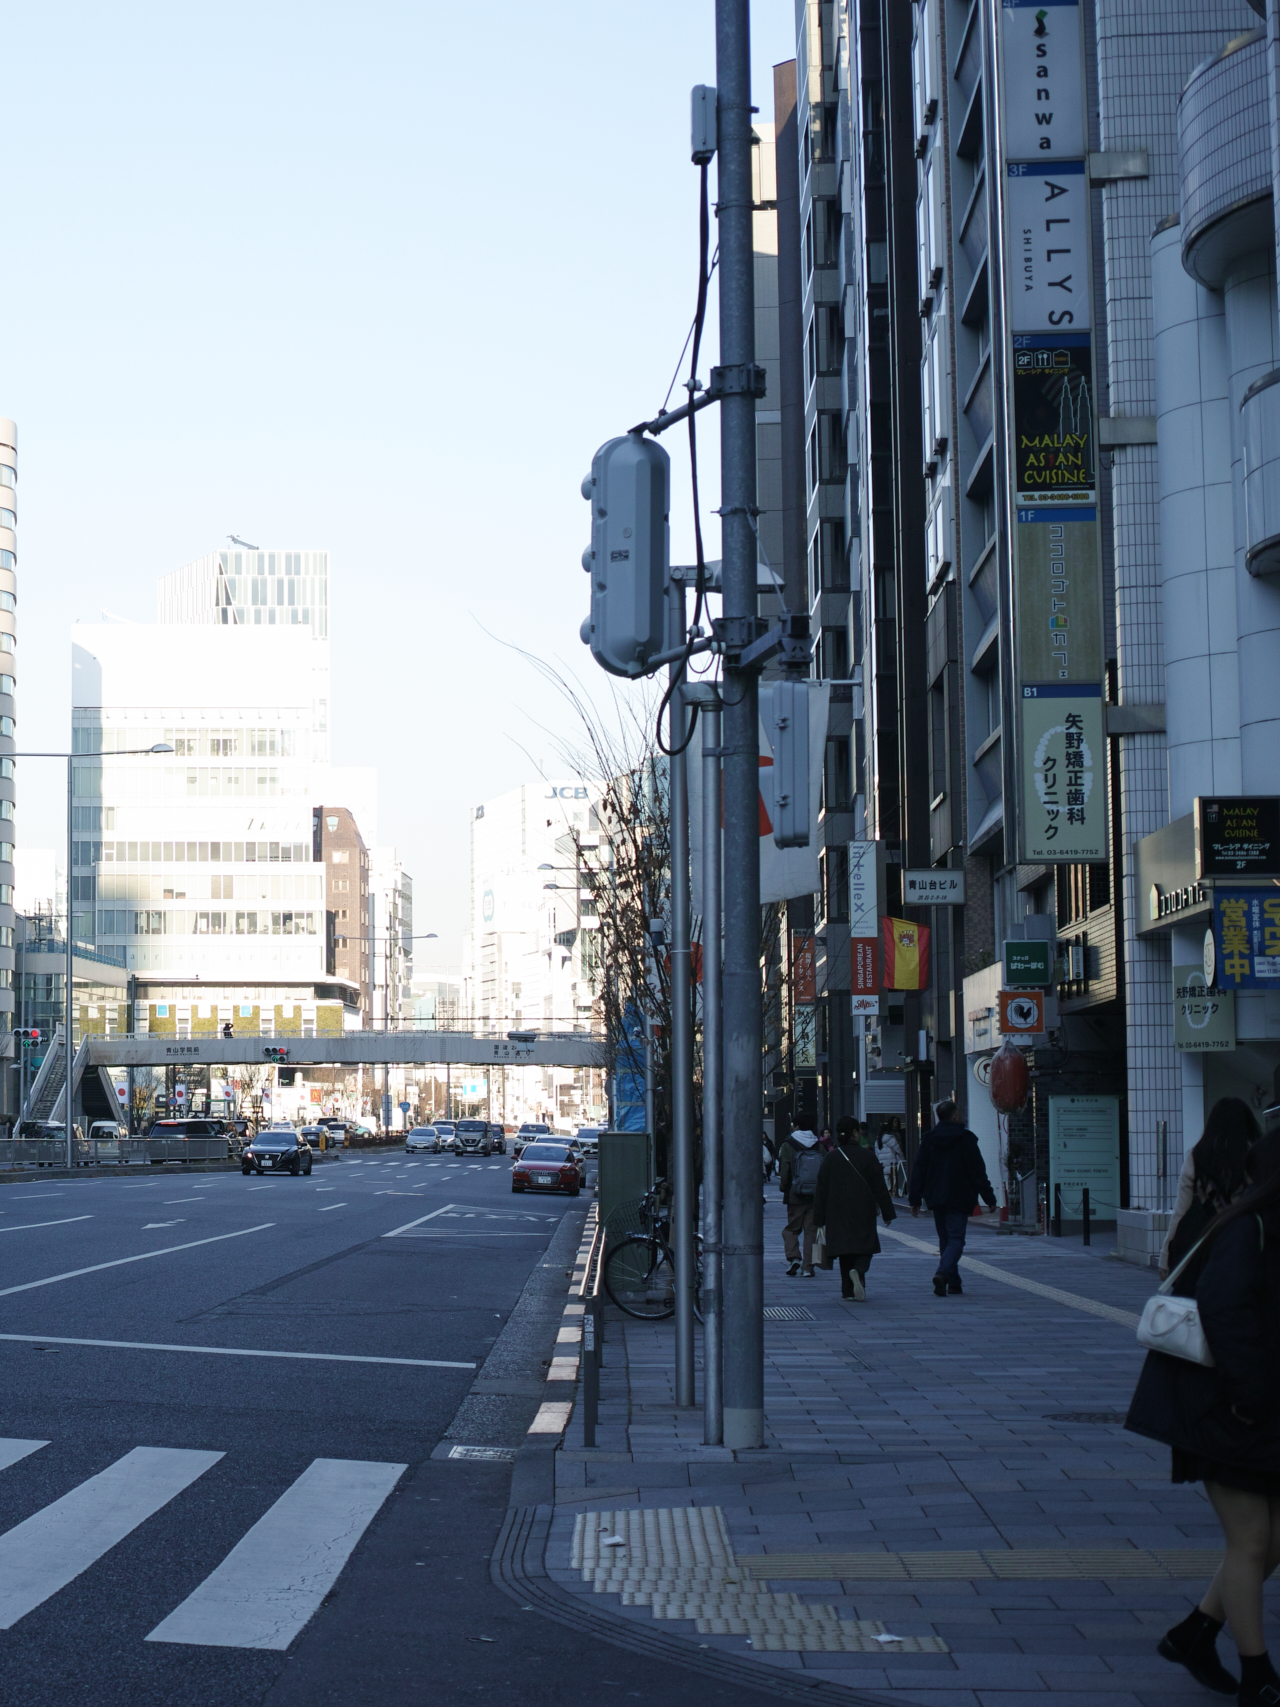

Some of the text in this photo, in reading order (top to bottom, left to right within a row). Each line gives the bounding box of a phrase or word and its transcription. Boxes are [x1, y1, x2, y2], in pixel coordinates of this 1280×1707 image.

[1034, 43, 1054, 150] sanwa
[1009, 164, 1028, 177] 3F
[1044, 181, 1074, 326] ALLYS
[1023, 229, 1033, 292] SHIBUYA
[1014, 336, 1031, 348] 2F
[1018, 356, 1031, 365] 2F
[1021, 434, 1088, 449] MALAY
[1024, 469, 1087, 484] CUISINE
[1020, 511, 1035, 522] 1F
[1024, 687, 1038, 697] B1
[1065, 713, 1086, 825] 矢野矯正歯科
[544, 786, 588, 800] JCB
[1043, 756, 1060, 841] クリニック
[1223, 808, 1260, 816] MALAY
[1224, 829, 1259, 838] CUISINE
[1236, 861, 1247, 869] 2F
[909, 880, 957, 890] 青山台ビル
[1220, 898, 1250, 983] 営業中
[1181, 1003, 1219, 1015] クリニック
[1185, 1041, 1230, 1049] 03-6419-7752
